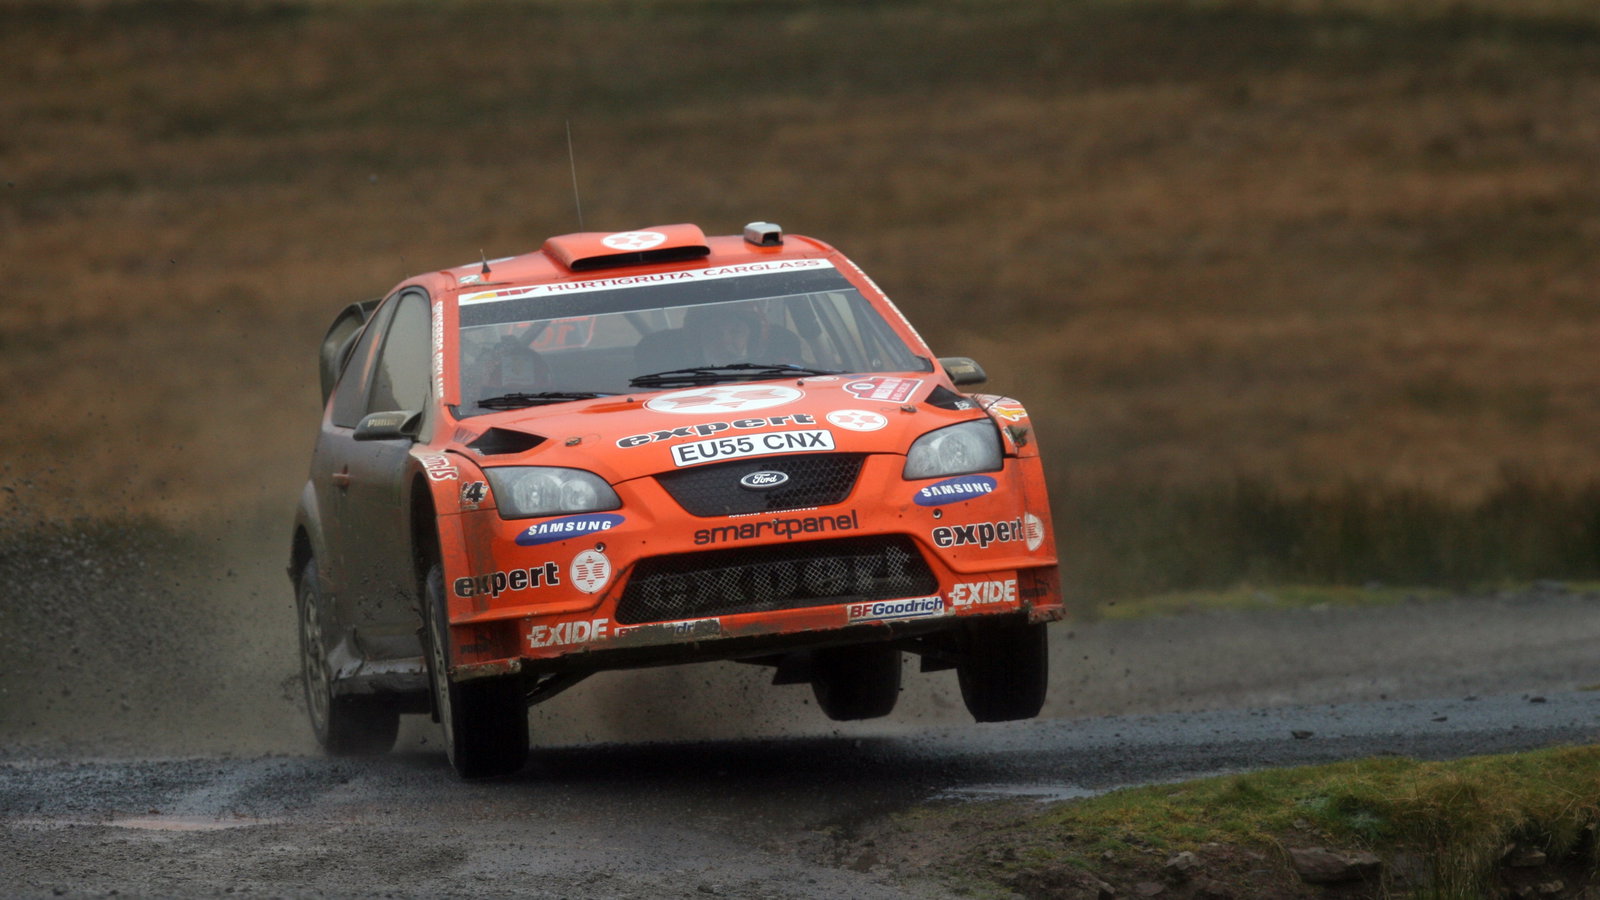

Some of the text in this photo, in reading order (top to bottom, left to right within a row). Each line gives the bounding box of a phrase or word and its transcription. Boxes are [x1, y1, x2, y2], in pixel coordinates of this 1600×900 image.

[548, 259, 821, 292] HURTIGRUTA CARGLASS
[616, 413, 816, 448] expert
[677, 431, 827, 463] EU55 CNX
[752, 472, 778, 485] Ford
[921, 482, 992, 497] SAMSUNG
[528, 520, 612, 535] SAMSUNG
[694, 509, 859, 545] smartpanel
[932, 517, 1024, 548] expert
[453, 561, 560, 599] expert
[948, 580, 1016, 606] EXIDE
[850, 598, 943, 617] BFGoodrich
[526, 619, 609, 648] EXIDE
